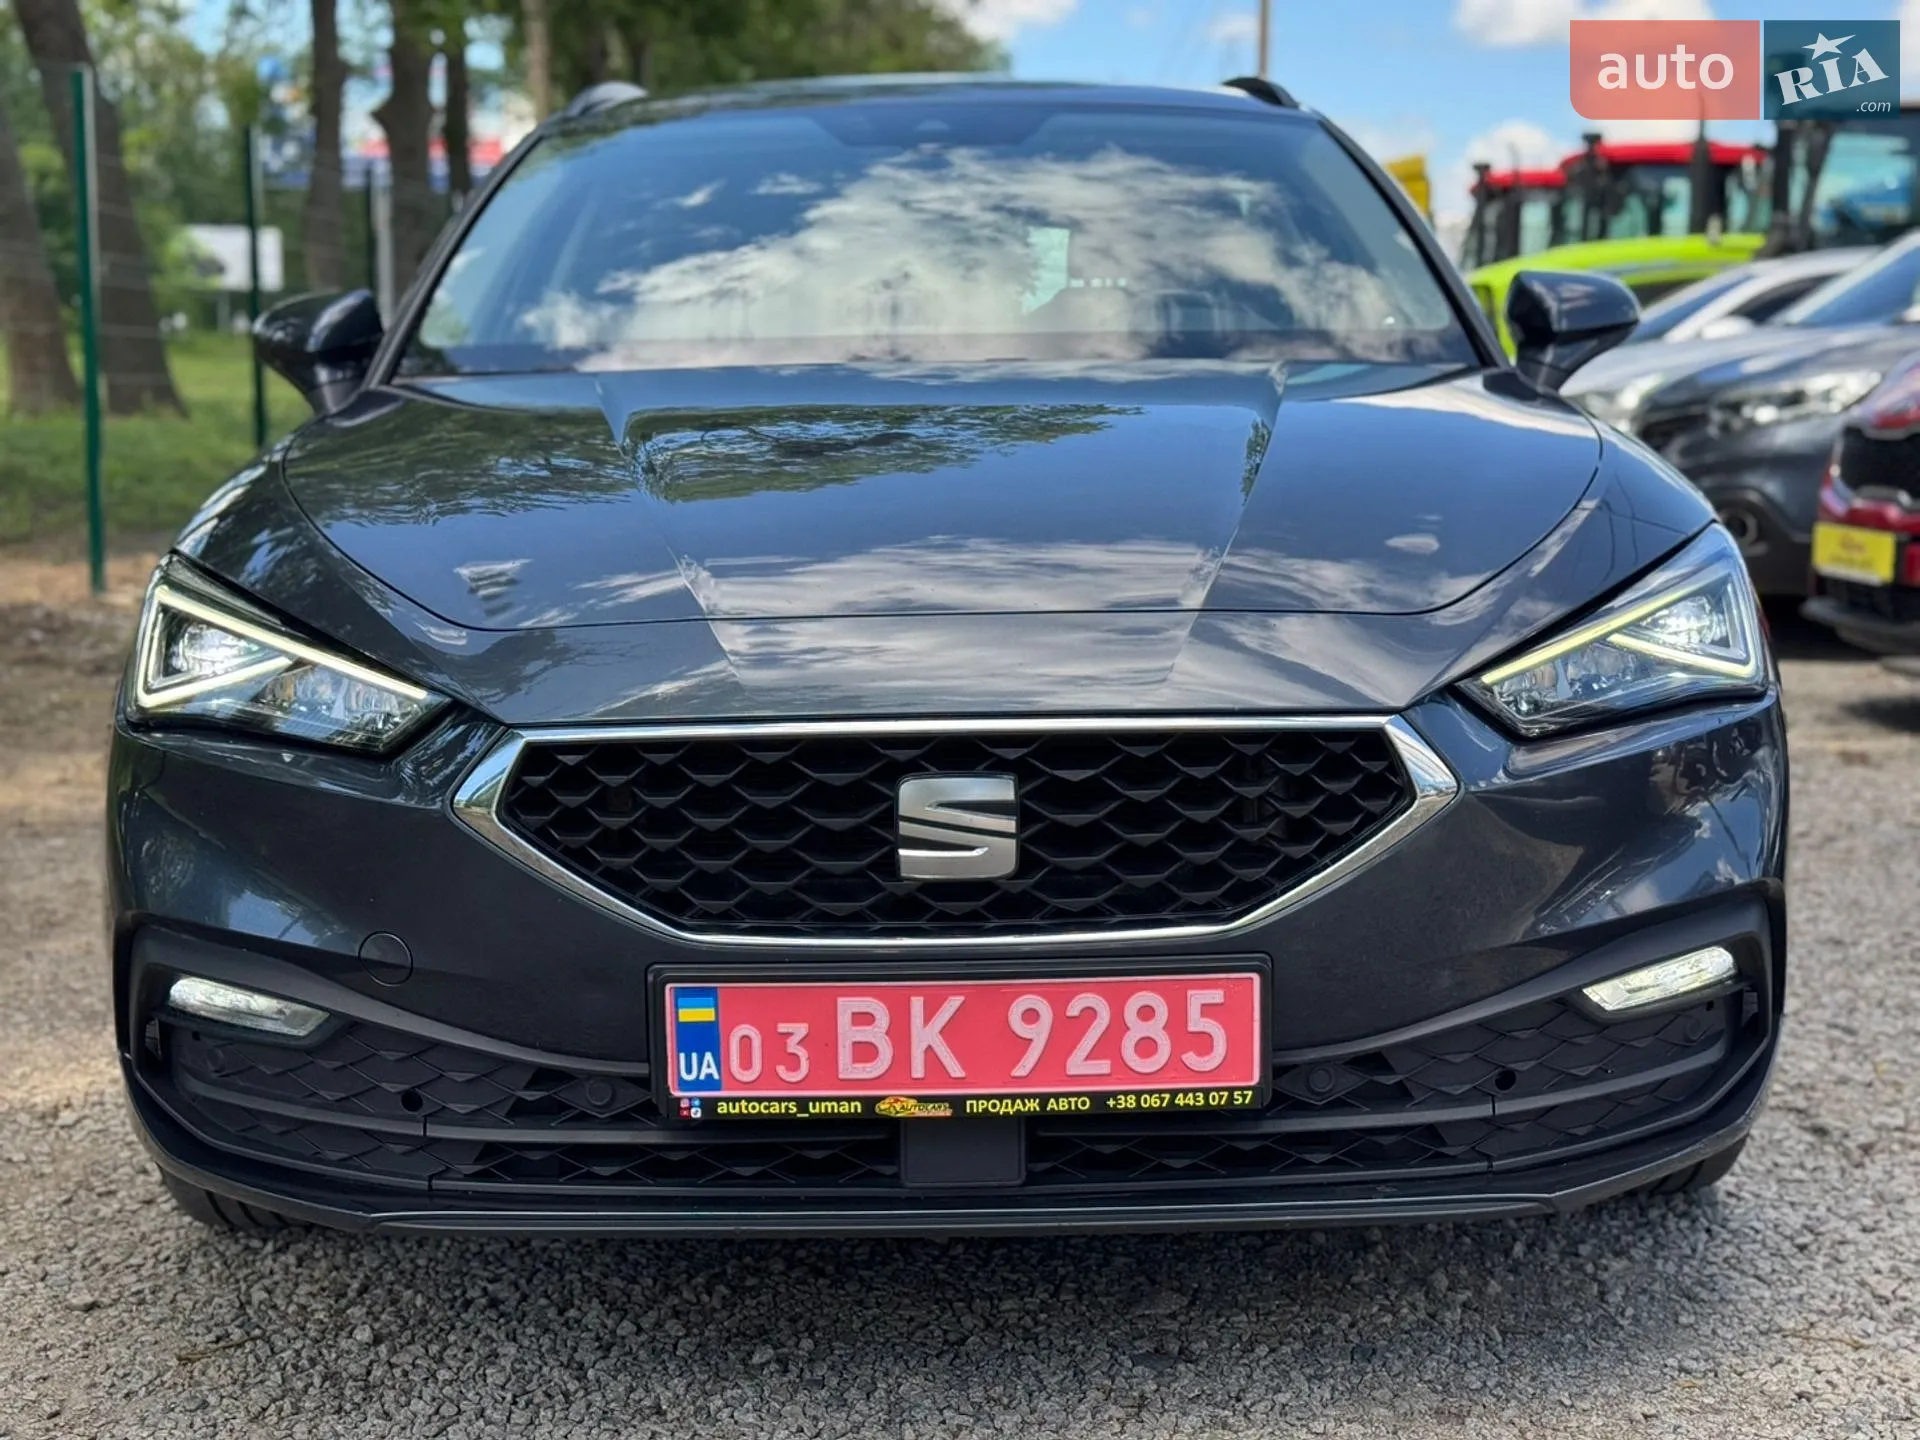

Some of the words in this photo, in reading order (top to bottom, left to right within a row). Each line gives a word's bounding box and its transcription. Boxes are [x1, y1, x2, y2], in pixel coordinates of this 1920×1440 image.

[729, 1022, 809, 1084] 03
[837, 995, 966, 1081] BK
[1008, 989, 1229, 1078] 9285
[680, 1052, 719, 1080] UA
[717, 1098, 862, 1117] autocars_uman
[966, 1097, 1040, 1116] ПРОДАЖ
[1046, 1096, 1091, 1112] АВТО
[1106, 1094, 1136, 1109] +38
[1140, 1093, 1170, 1108] 067
[1174, 1092, 1204, 1107] 443
[1208, 1091, 1228, 1106] 07
[1233, 1090, 1253, 1105] 57
